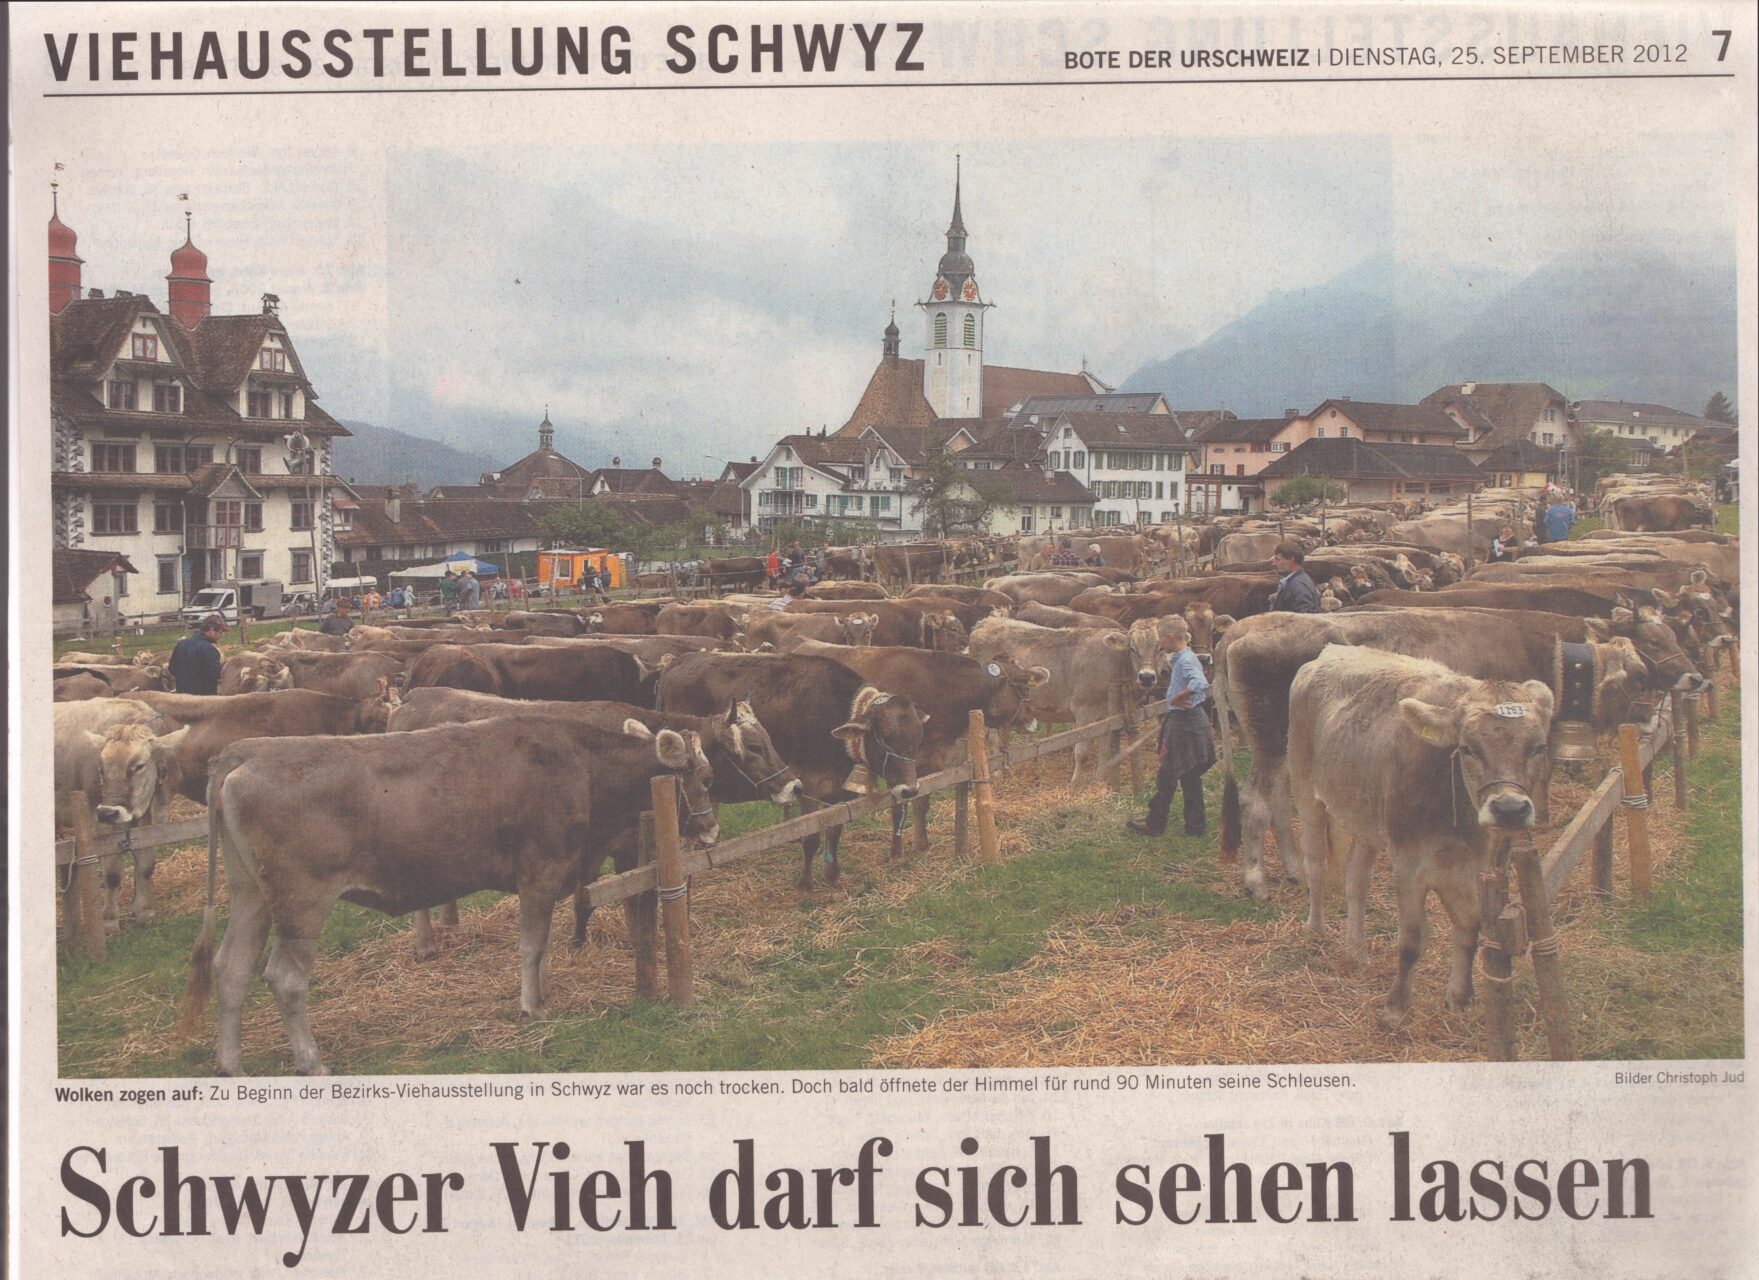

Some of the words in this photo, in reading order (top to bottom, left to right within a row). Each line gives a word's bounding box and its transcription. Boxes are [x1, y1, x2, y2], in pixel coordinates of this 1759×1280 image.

[43, 25, 632, 82] VIEHAUSSTELLUNG
[665, 22, 925, 74] SCHWYZ
[1064, 50, 1121, 70] BOTE
[1128, 50, 1172, 69] DER
[1180, 48, 1310, 69] URSCHWEIZ
[1329, 46, 1442, 68] DIENSTAG,
[1451, 46, 1484, 65] 25.
[1493, 44, 1624, 65] SEPTEMBER
[1633, 43, 1687, 63] 2012
[1711, 29, 1732, 62] 7
[54, 1086, 114, 1103] Wolken
[119, 1089, 166, 1105] zogen
[171, 1085, 204, 1102] auf:
[209, 1085, 230, 1101] Zu
[237, 1085, 293, 1104] Beginn
[299, 1084, 325, 1100] der
[331, 1082, 524, 1101] Bezirks-Viehausstellung
[530, 1081, 545, 1097] in
[551, 1081, 612, 1100] Schwyz
[616, 1084, 646, 1096] war
[650, 1083, 669, 1096] es
[675, 1079, 713, 1096] noch
[719, 1079, 785, 1095] trocken.
[792, 1078, 832, 1094] Doch
[839, 1077, 873, 1094] bald
[879, 1077, 937, 1093] öffnete
[942, 1077, 969, 1093] der
[975, 1076, 1038, 1092] Himmel
[1044, 1075, 1068, 1091] für
[1073, 1075, 1110, 1091] rund
[1116, 1074, 1139, 1090] 90
[1146, 1074, 1212, 1090] Minuten
[1218, 1076, 1261, 1089] seine
[1267, 1072, 1356, 1089] Schleusen.
[1615, 1072, 1653, 1085] Bilder
[1656, 1071, 1718, 1086] Christoph
[1721, 1071, 1745, 1083] Jud
[60, 1145, 465, 1269] Schwyzer
[489, 1140, 677, 1232] Vieh
[708, 1136, 894, 1231] darf
[915, 1135, 1083, 1229] sich
[1115, 1133, 1359, 1226] sehen
[1388, 1130, 1655, 1223] lassen
